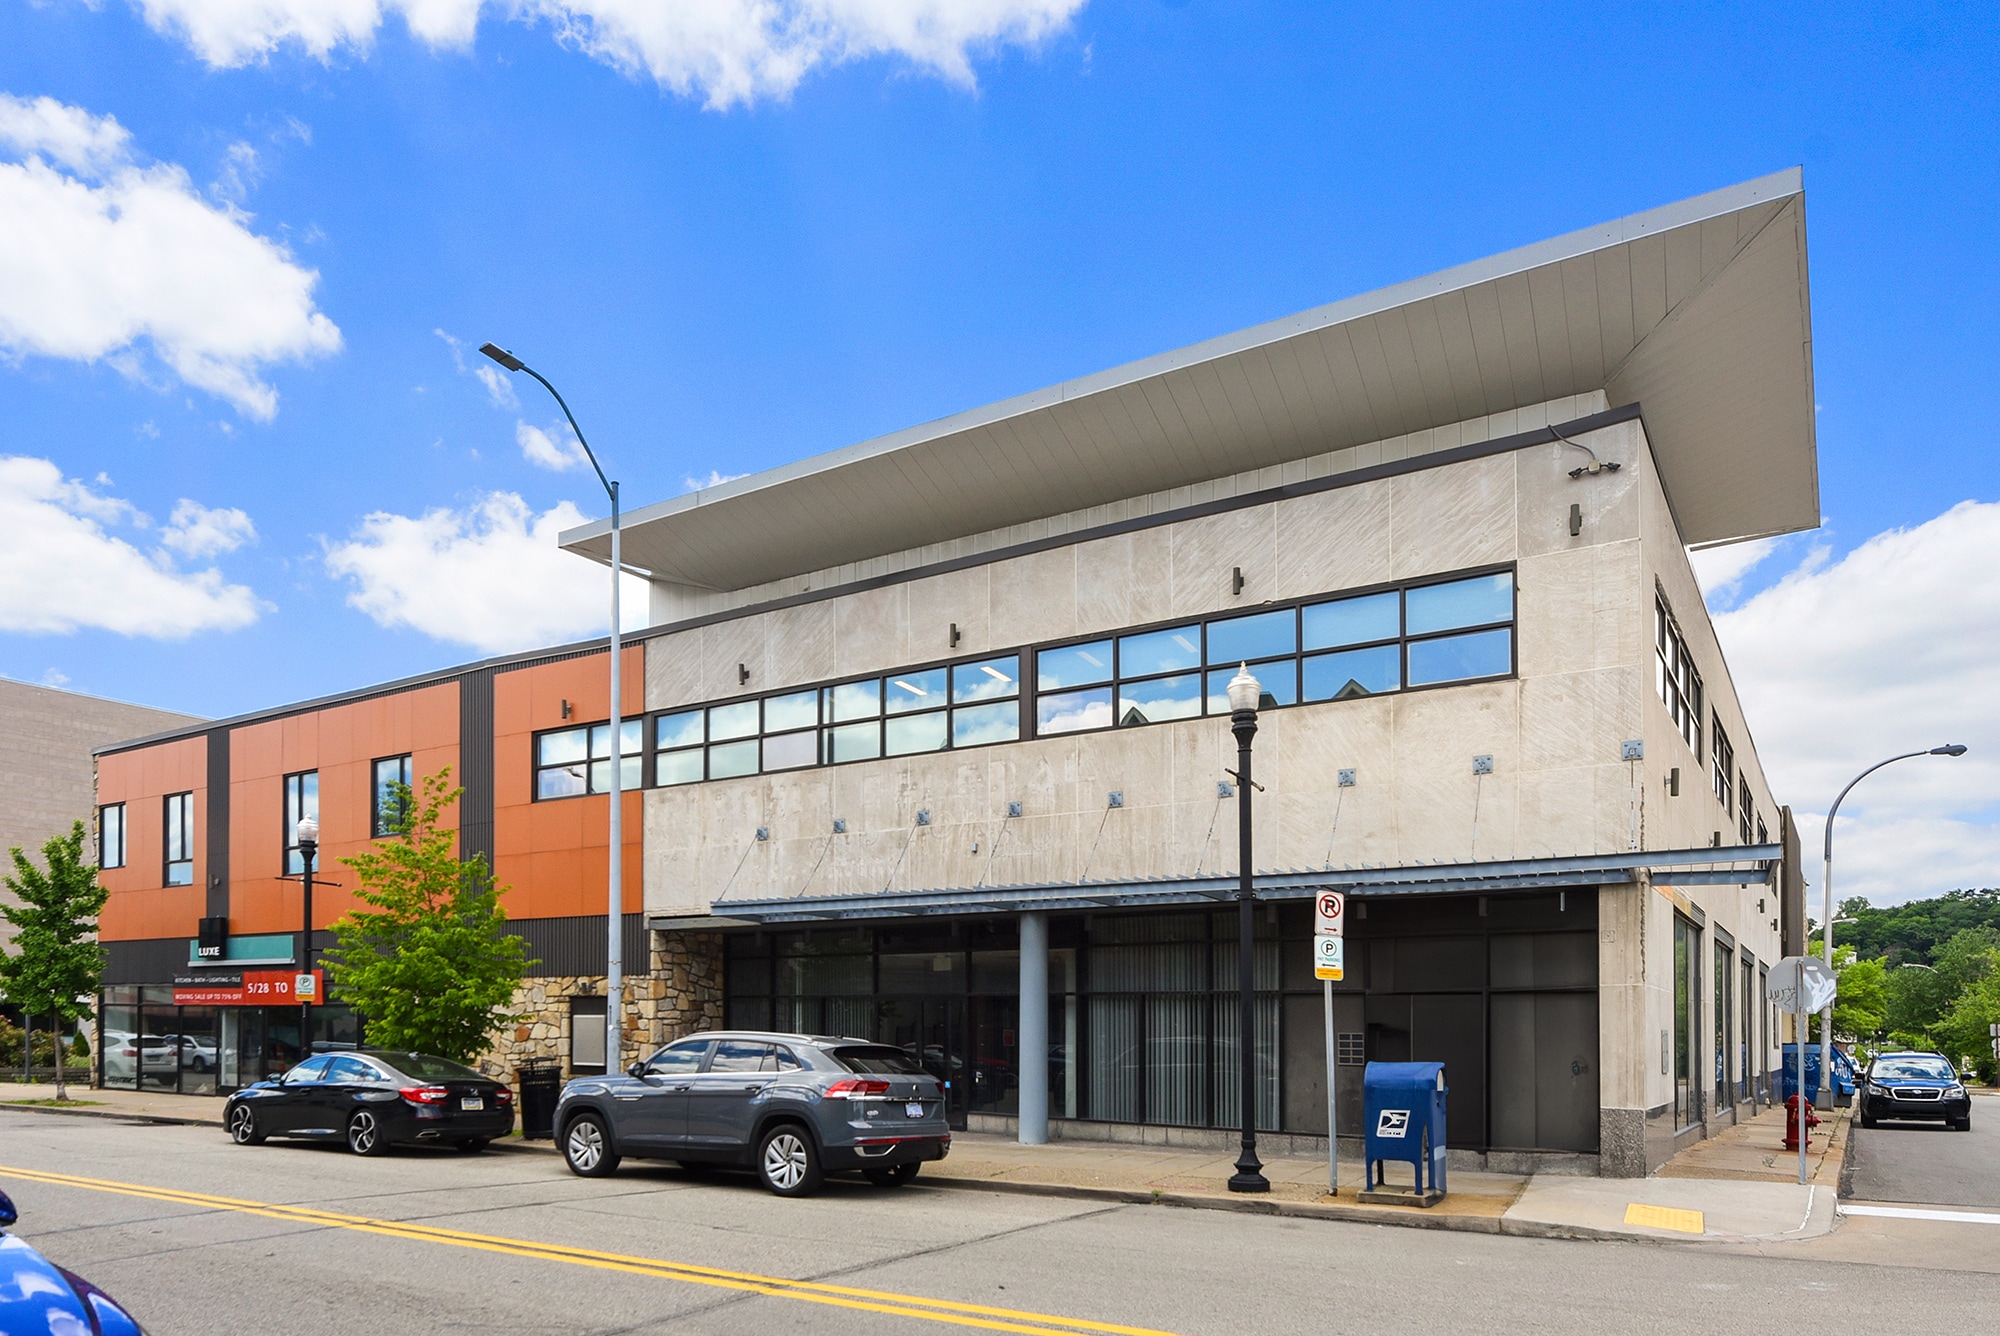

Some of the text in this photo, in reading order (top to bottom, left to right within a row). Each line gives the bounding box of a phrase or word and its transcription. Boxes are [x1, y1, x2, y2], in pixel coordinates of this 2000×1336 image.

[198, 946, 220, 956] LUXE
[1326, 943, 1334, 953] P
[247, 982, 270, 994] 5/28
[274, 982, 288, 993] TO
